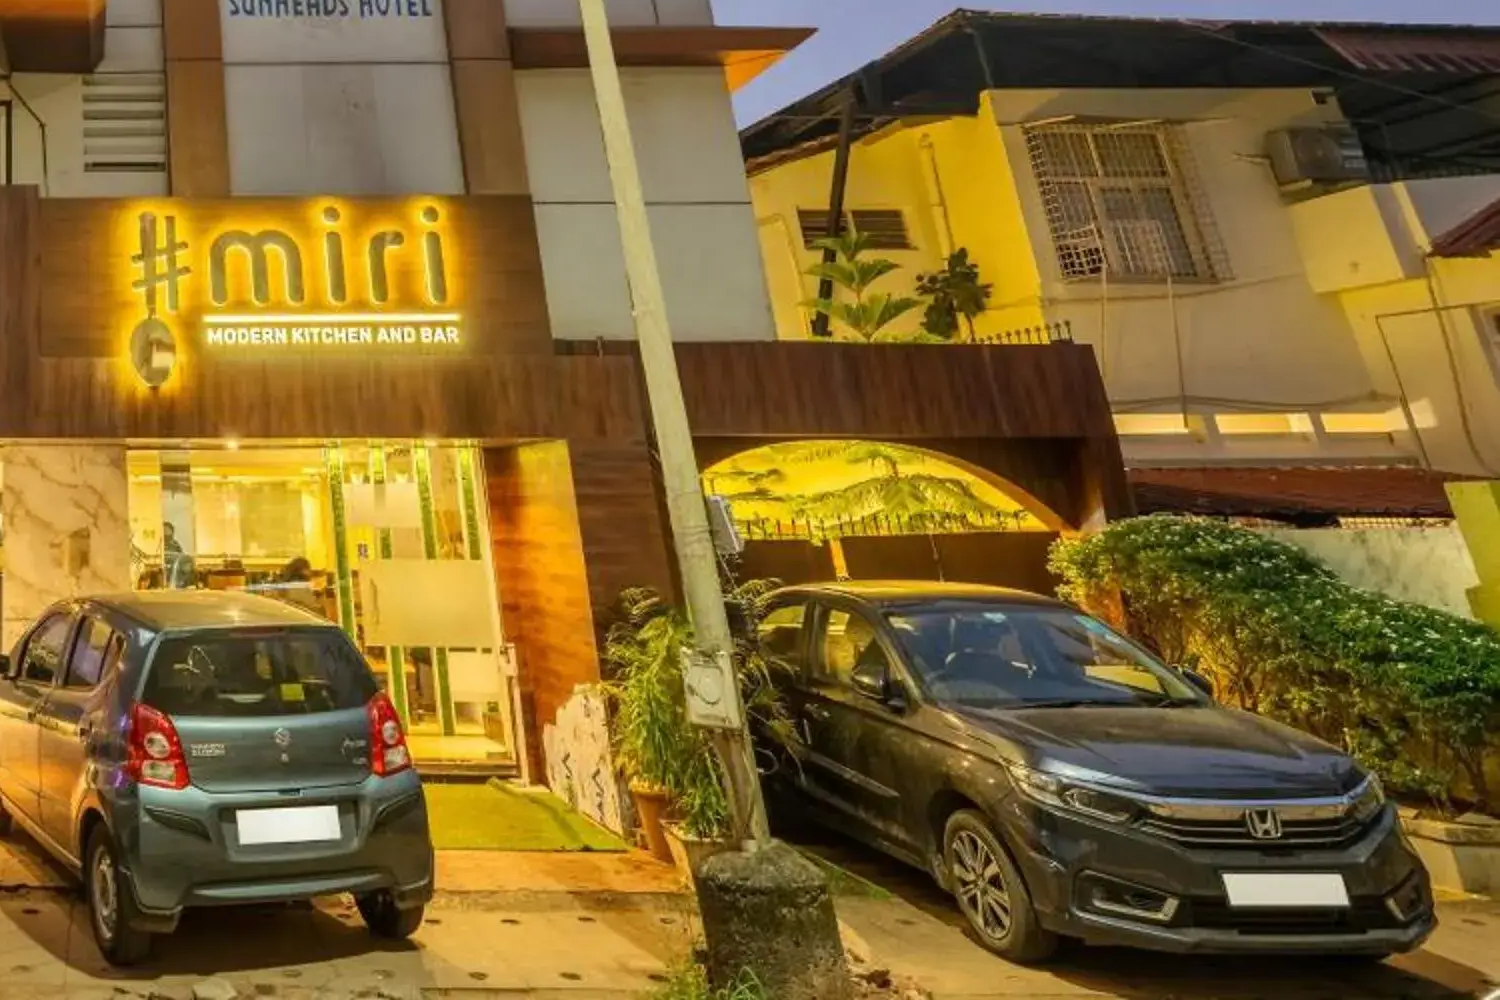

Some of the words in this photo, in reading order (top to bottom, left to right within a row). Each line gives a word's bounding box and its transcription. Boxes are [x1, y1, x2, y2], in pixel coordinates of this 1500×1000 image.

[207, 327, 288, 345] MODERN
[291, 327, 372, 345] KITCHEN
[377, 327, 416, 345] AND
[420, 327, 460, 345] BAR
